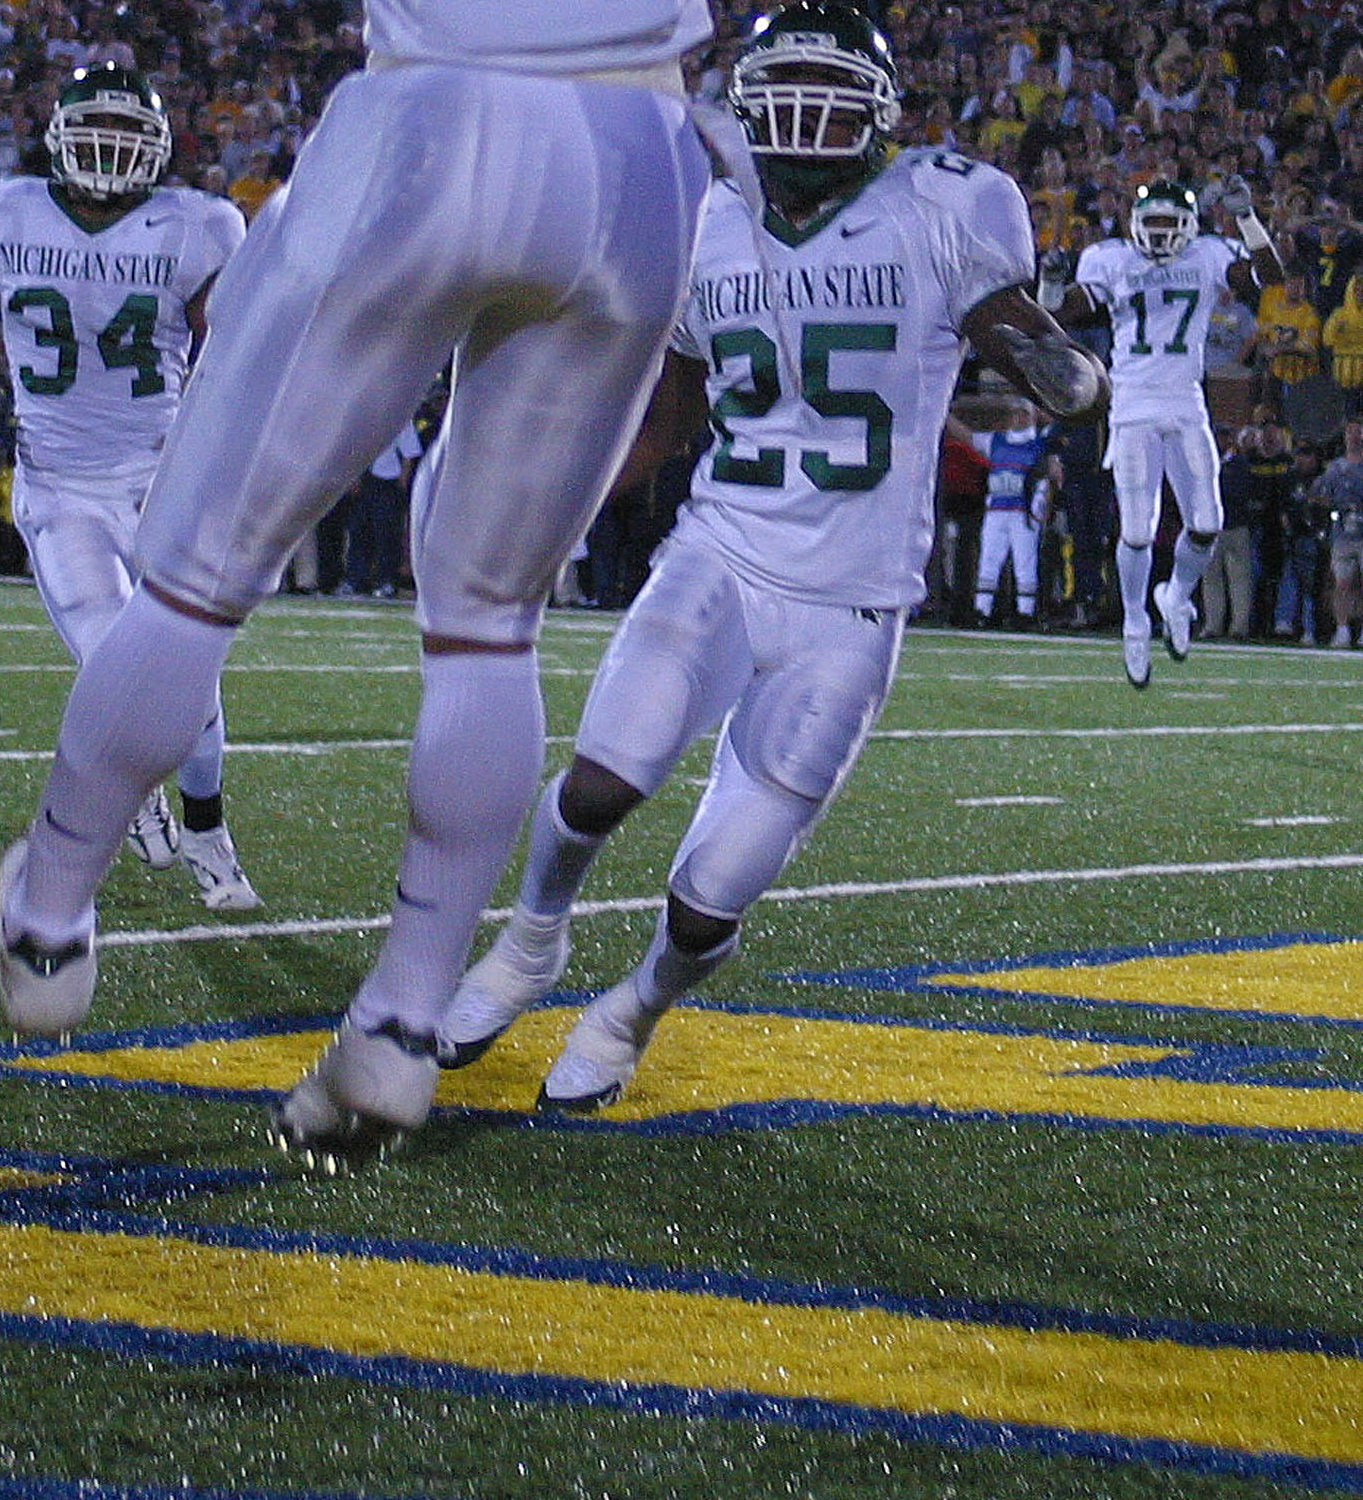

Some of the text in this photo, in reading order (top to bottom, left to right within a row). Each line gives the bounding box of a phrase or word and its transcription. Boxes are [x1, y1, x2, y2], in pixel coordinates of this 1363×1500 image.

[0, 242, 179, 288] MICHIGAN STATE
[824, 264, 906, 308] STATE
[8, 287, 166, 398] 34
[1129, 289, 1200, 355] 17
[711, 322, 899, 493] 25
